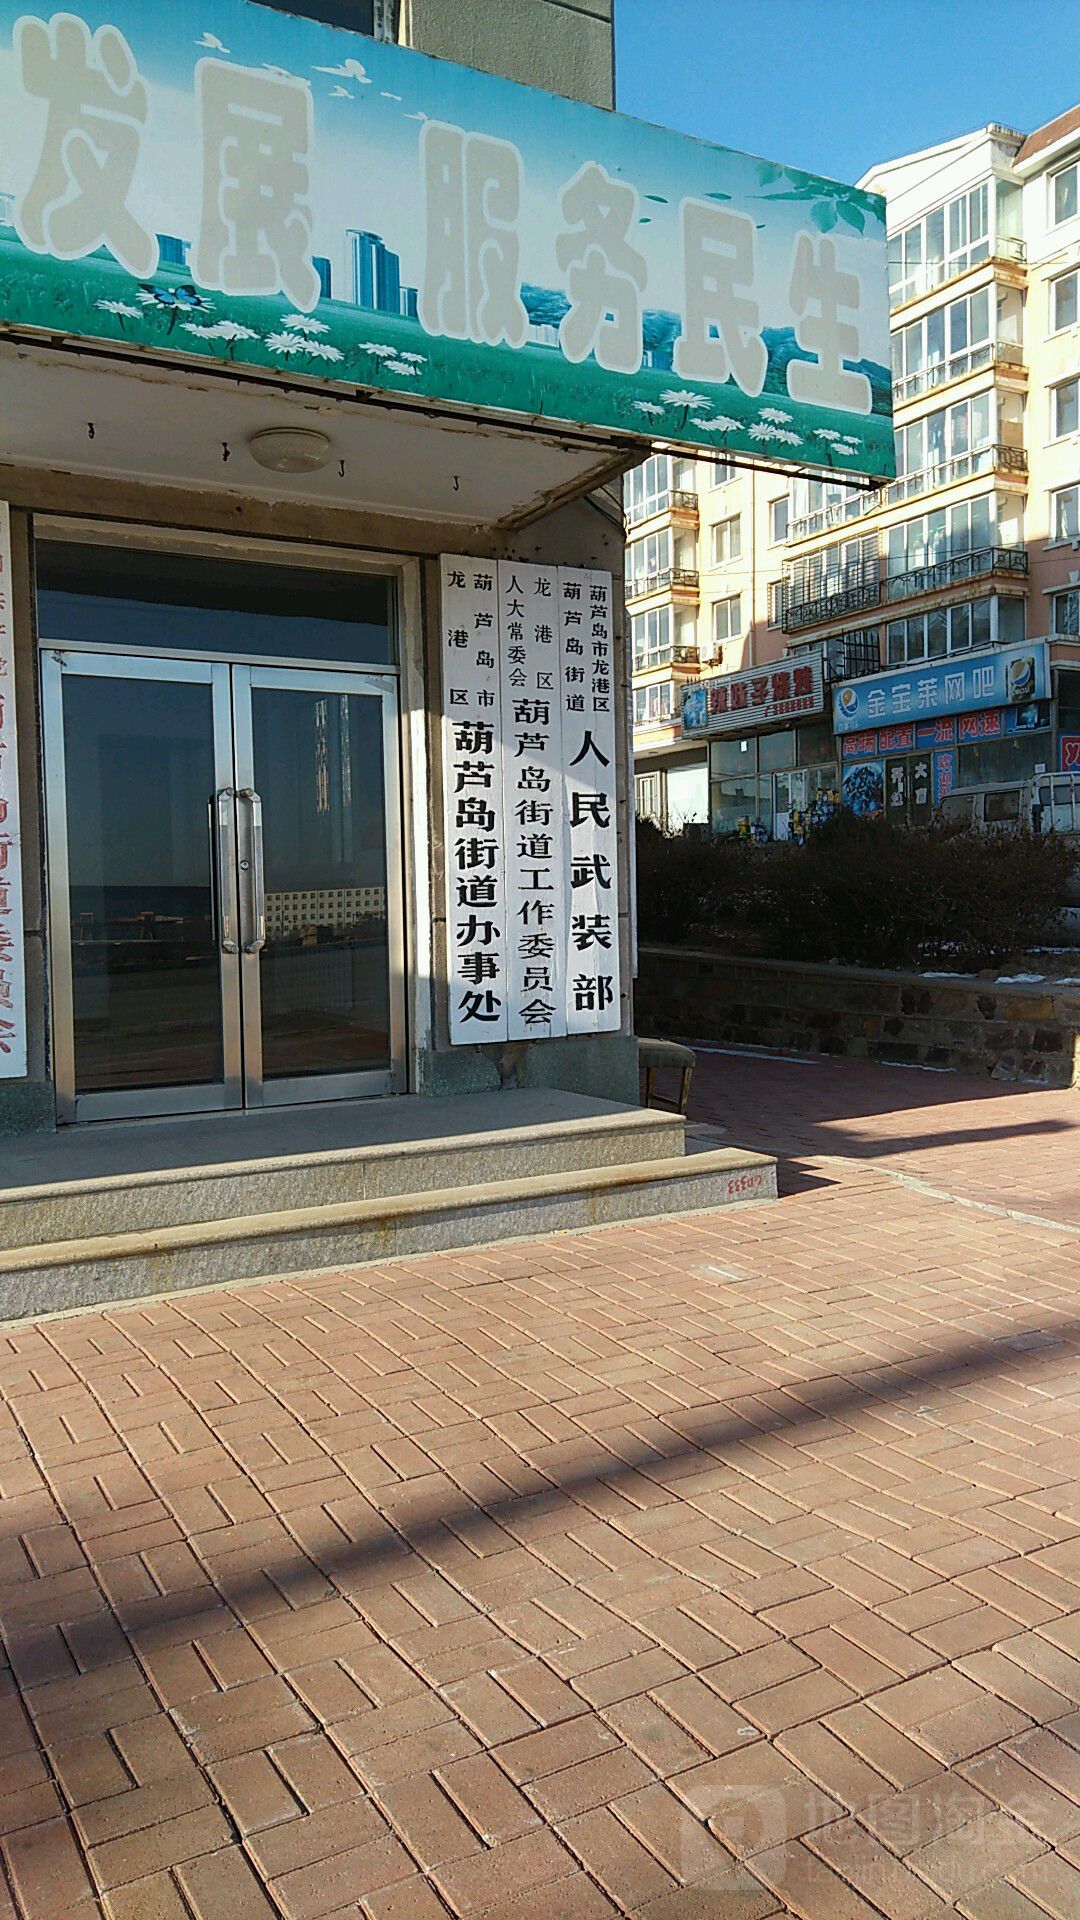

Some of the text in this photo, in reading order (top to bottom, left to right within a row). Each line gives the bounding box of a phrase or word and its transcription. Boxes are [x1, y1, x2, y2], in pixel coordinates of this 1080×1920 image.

[12, 14, 873, 416] 发展 服务民生
[447, 570, 470, 706] 龙港区
[473, 573, 496, 708] 葫芦岛市
[505, 574, 528, 688] 人大常委会
[533, 577, 554, 691] 龙港区
[563, 582, 586, 713] 葫芦岛街道
[589, 584, 611, 713] 葫芦岛市龙港区
[453, 721, 501, 1023] 葫芦岛街道办事处
[512, 697, 556, 1026] 葫芦岛街道工作委员会
[569, 730, 614, 1011] 人民武装部
